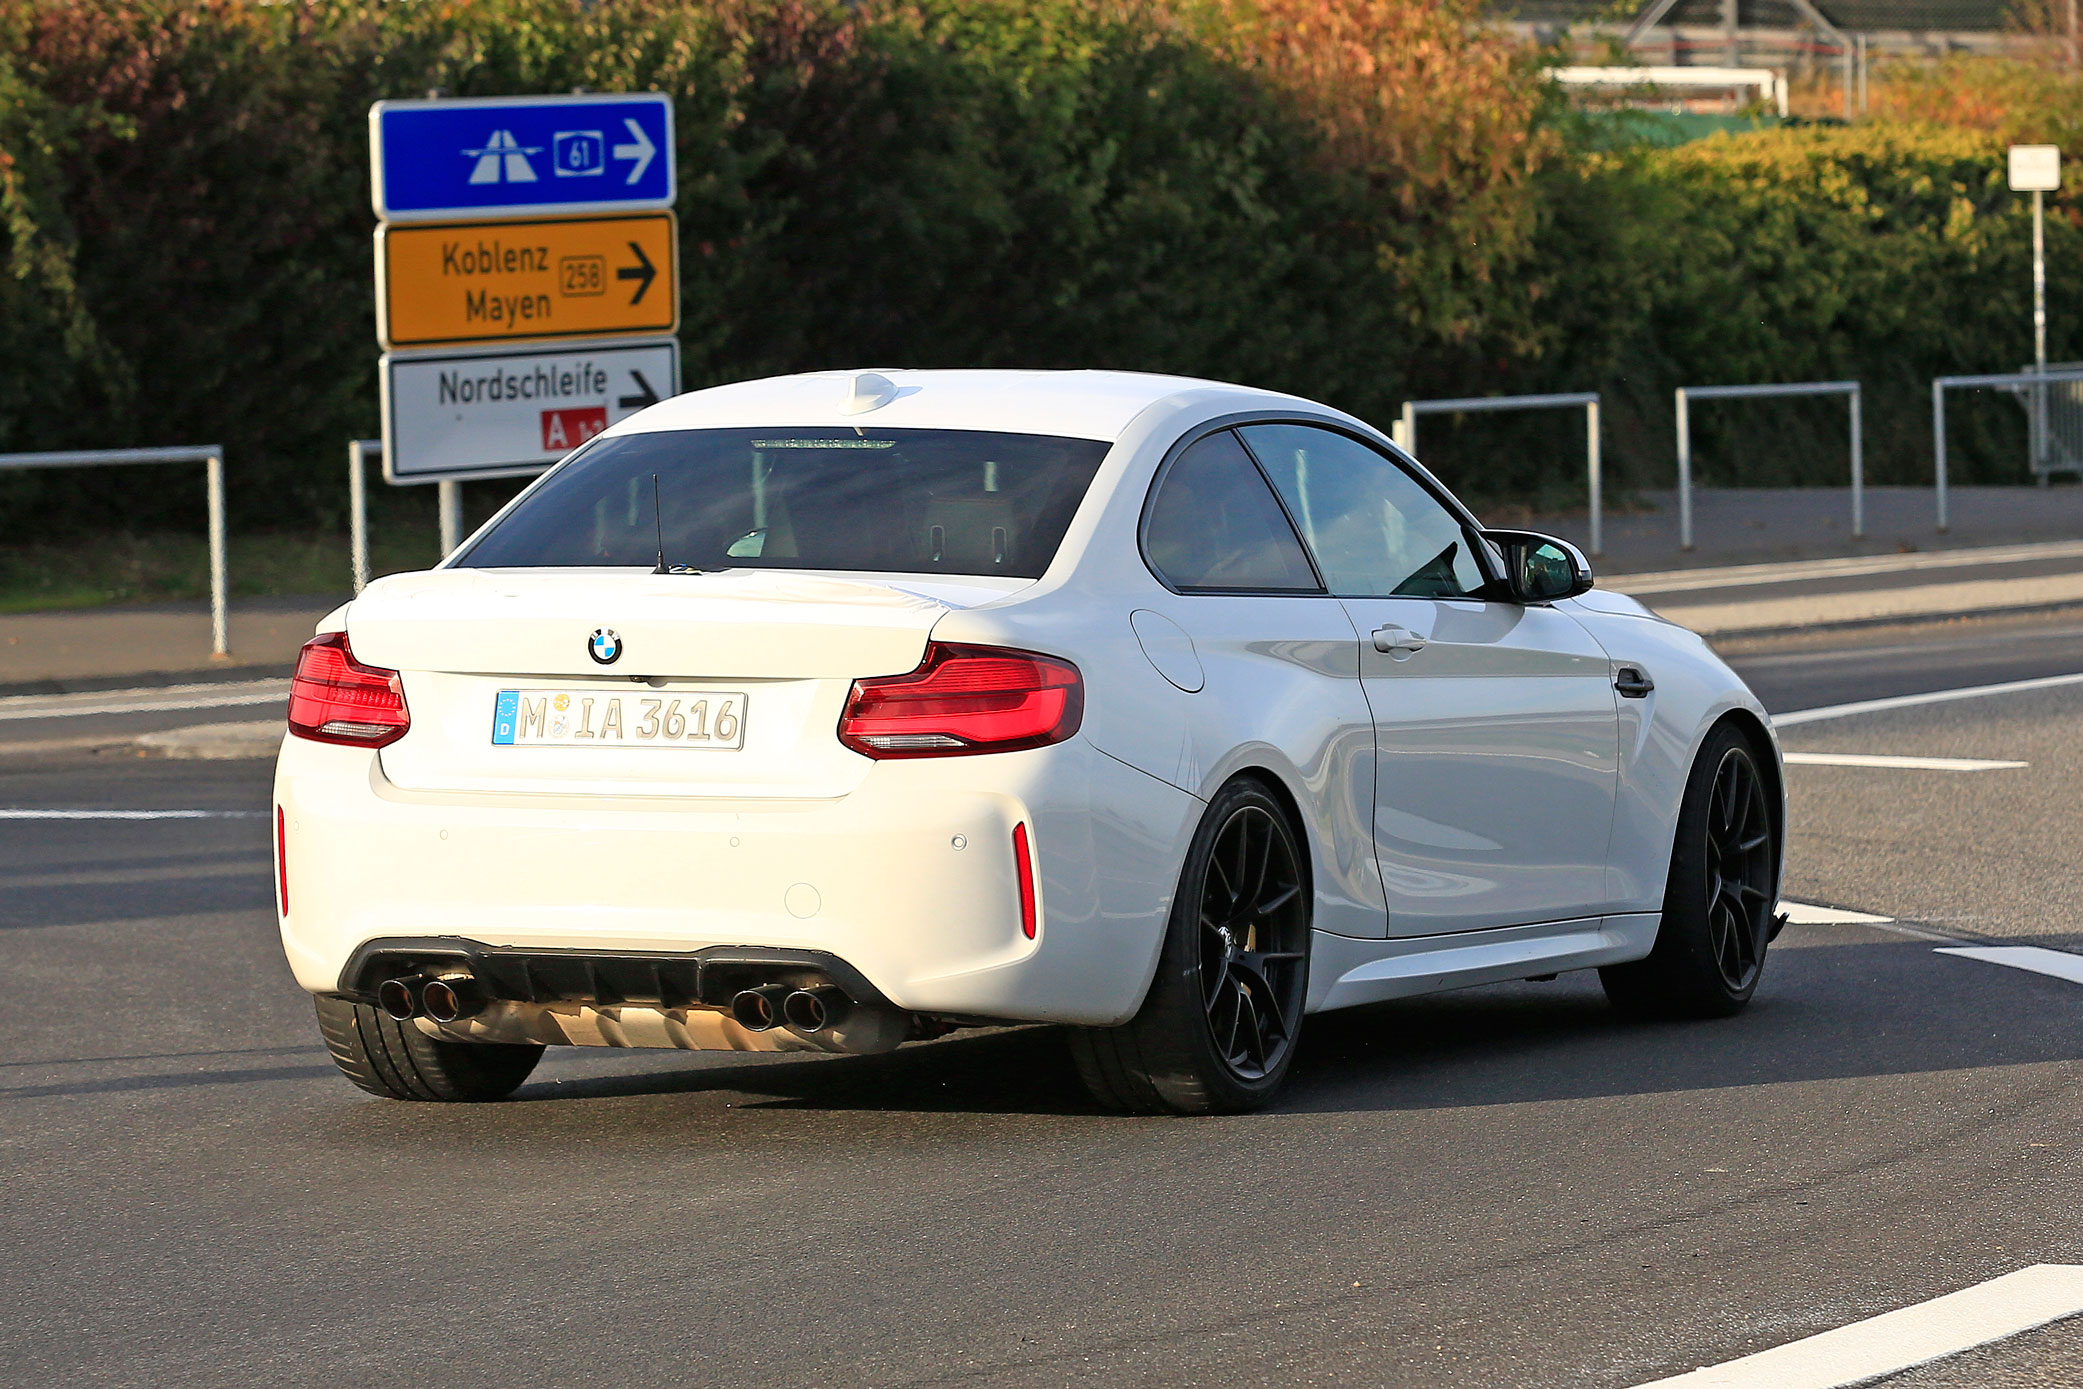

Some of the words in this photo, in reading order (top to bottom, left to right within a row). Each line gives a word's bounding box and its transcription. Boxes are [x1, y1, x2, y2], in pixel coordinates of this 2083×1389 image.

[569, 140, 590, 167] 61
[442, 240, 549, 275] Koblenz
[565, 262, 600, 289] 258
[466, 288, 551, 329] Mayen
[439, 362, 608, 405] Nordschleife
[546, 413, 569, 448] A
[500, 722, 510, 736] D
[519, 697, 547, 739] M
[635, 698, 738, 741] 3616
